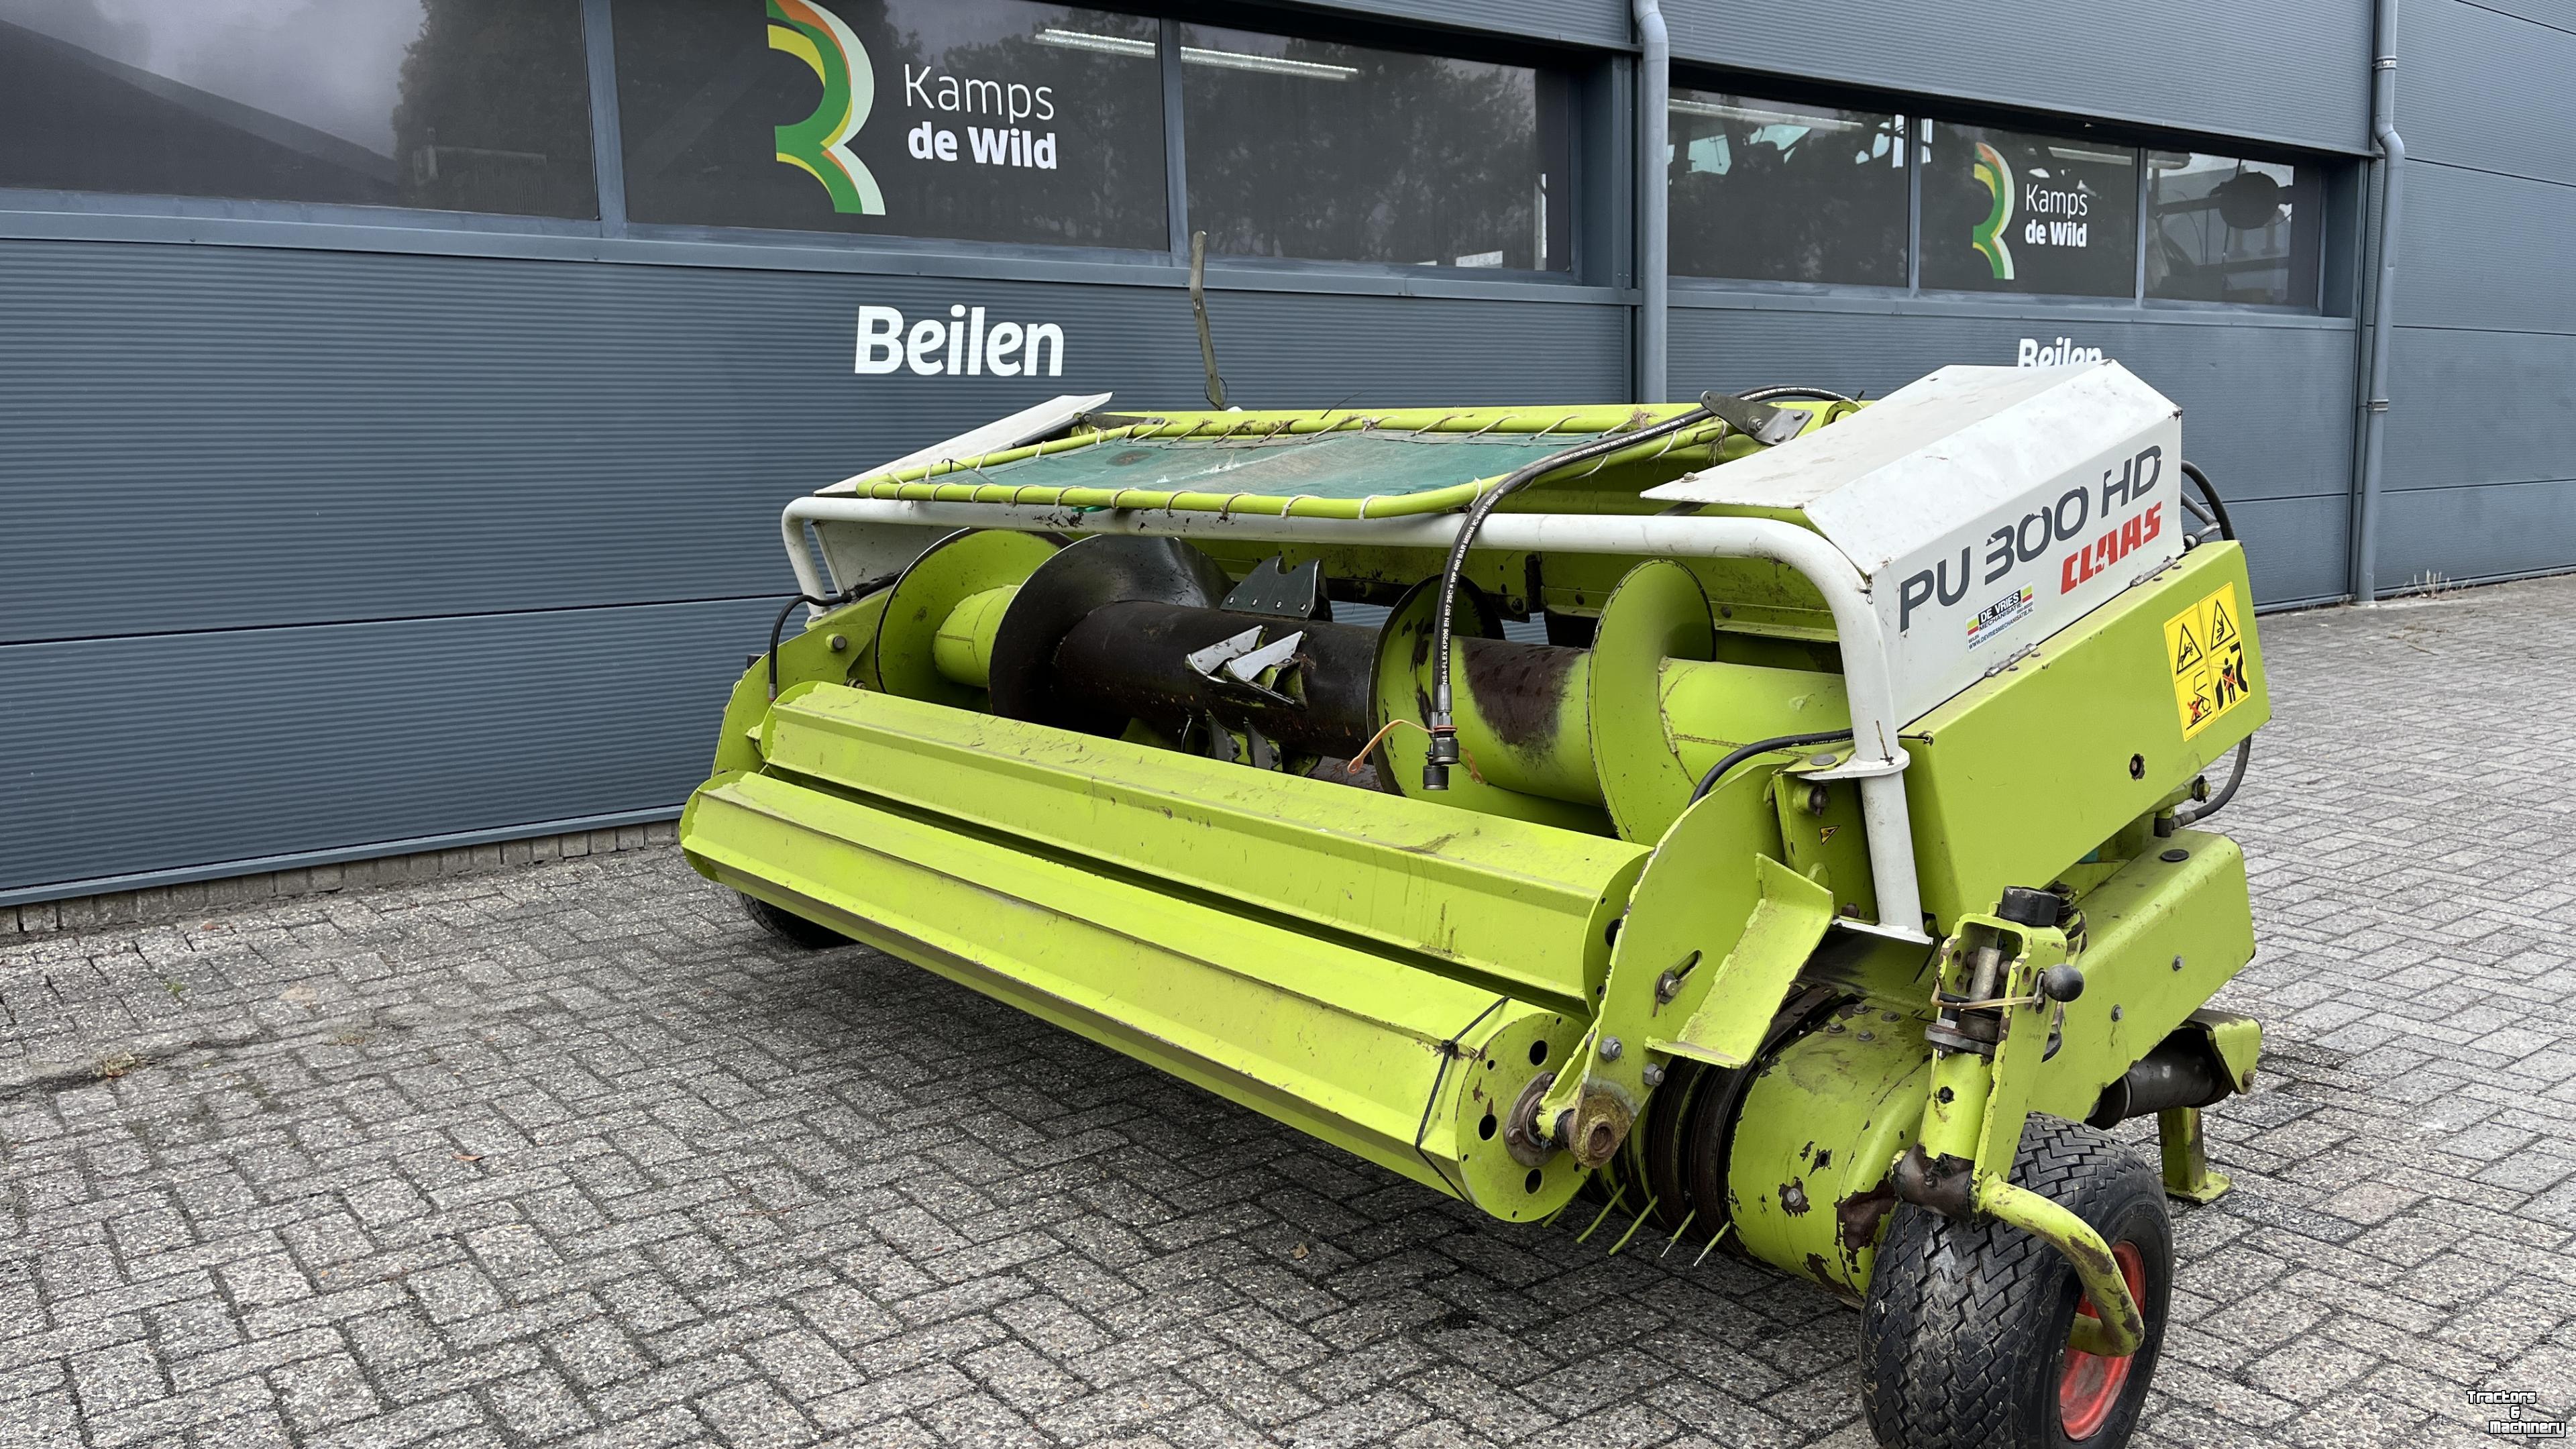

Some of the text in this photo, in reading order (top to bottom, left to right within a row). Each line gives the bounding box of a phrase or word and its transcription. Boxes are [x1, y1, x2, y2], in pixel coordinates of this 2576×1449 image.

[904, 63, 1055, 124] Kamps
[908, 121, 1057, 170] de Wild
[2026, 183, 2088, 219] Kamps
[2025, 219, 2088, 248] de Wild
[854, 304, 1065, 377] Beilen
[1900, 445, 2162, 633] PU 300 HD
[2061, 500, 2162, 595] CLAAS
[1443, 617, 1450, 628] EN
[1457, 545, 1467, 559] BAR
[1980, 608, 1993, 623] DE
[1994, 592, 2019, 613] VRIES
[1979, 602, 2022, 631] MECHANISATIE
